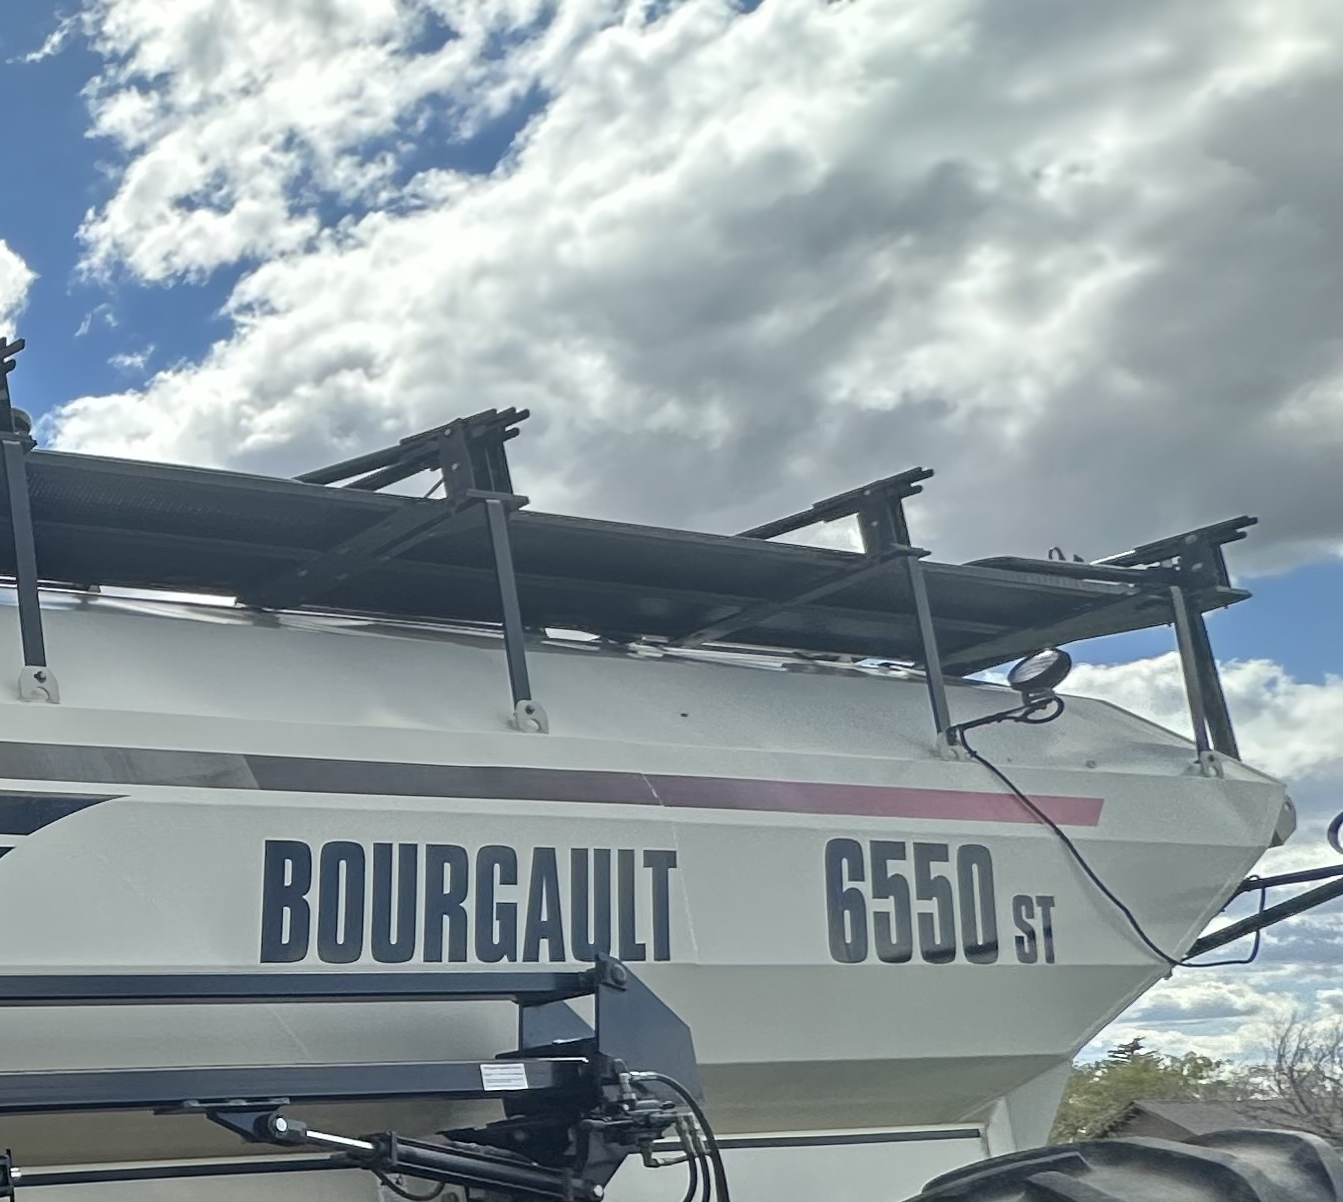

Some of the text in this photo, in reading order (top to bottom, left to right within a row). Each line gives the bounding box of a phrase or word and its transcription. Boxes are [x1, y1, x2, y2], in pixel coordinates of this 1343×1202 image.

[260, 839, 678, 964] BOURGAULT
[824, 838, 1056, 965] 6550 ST
